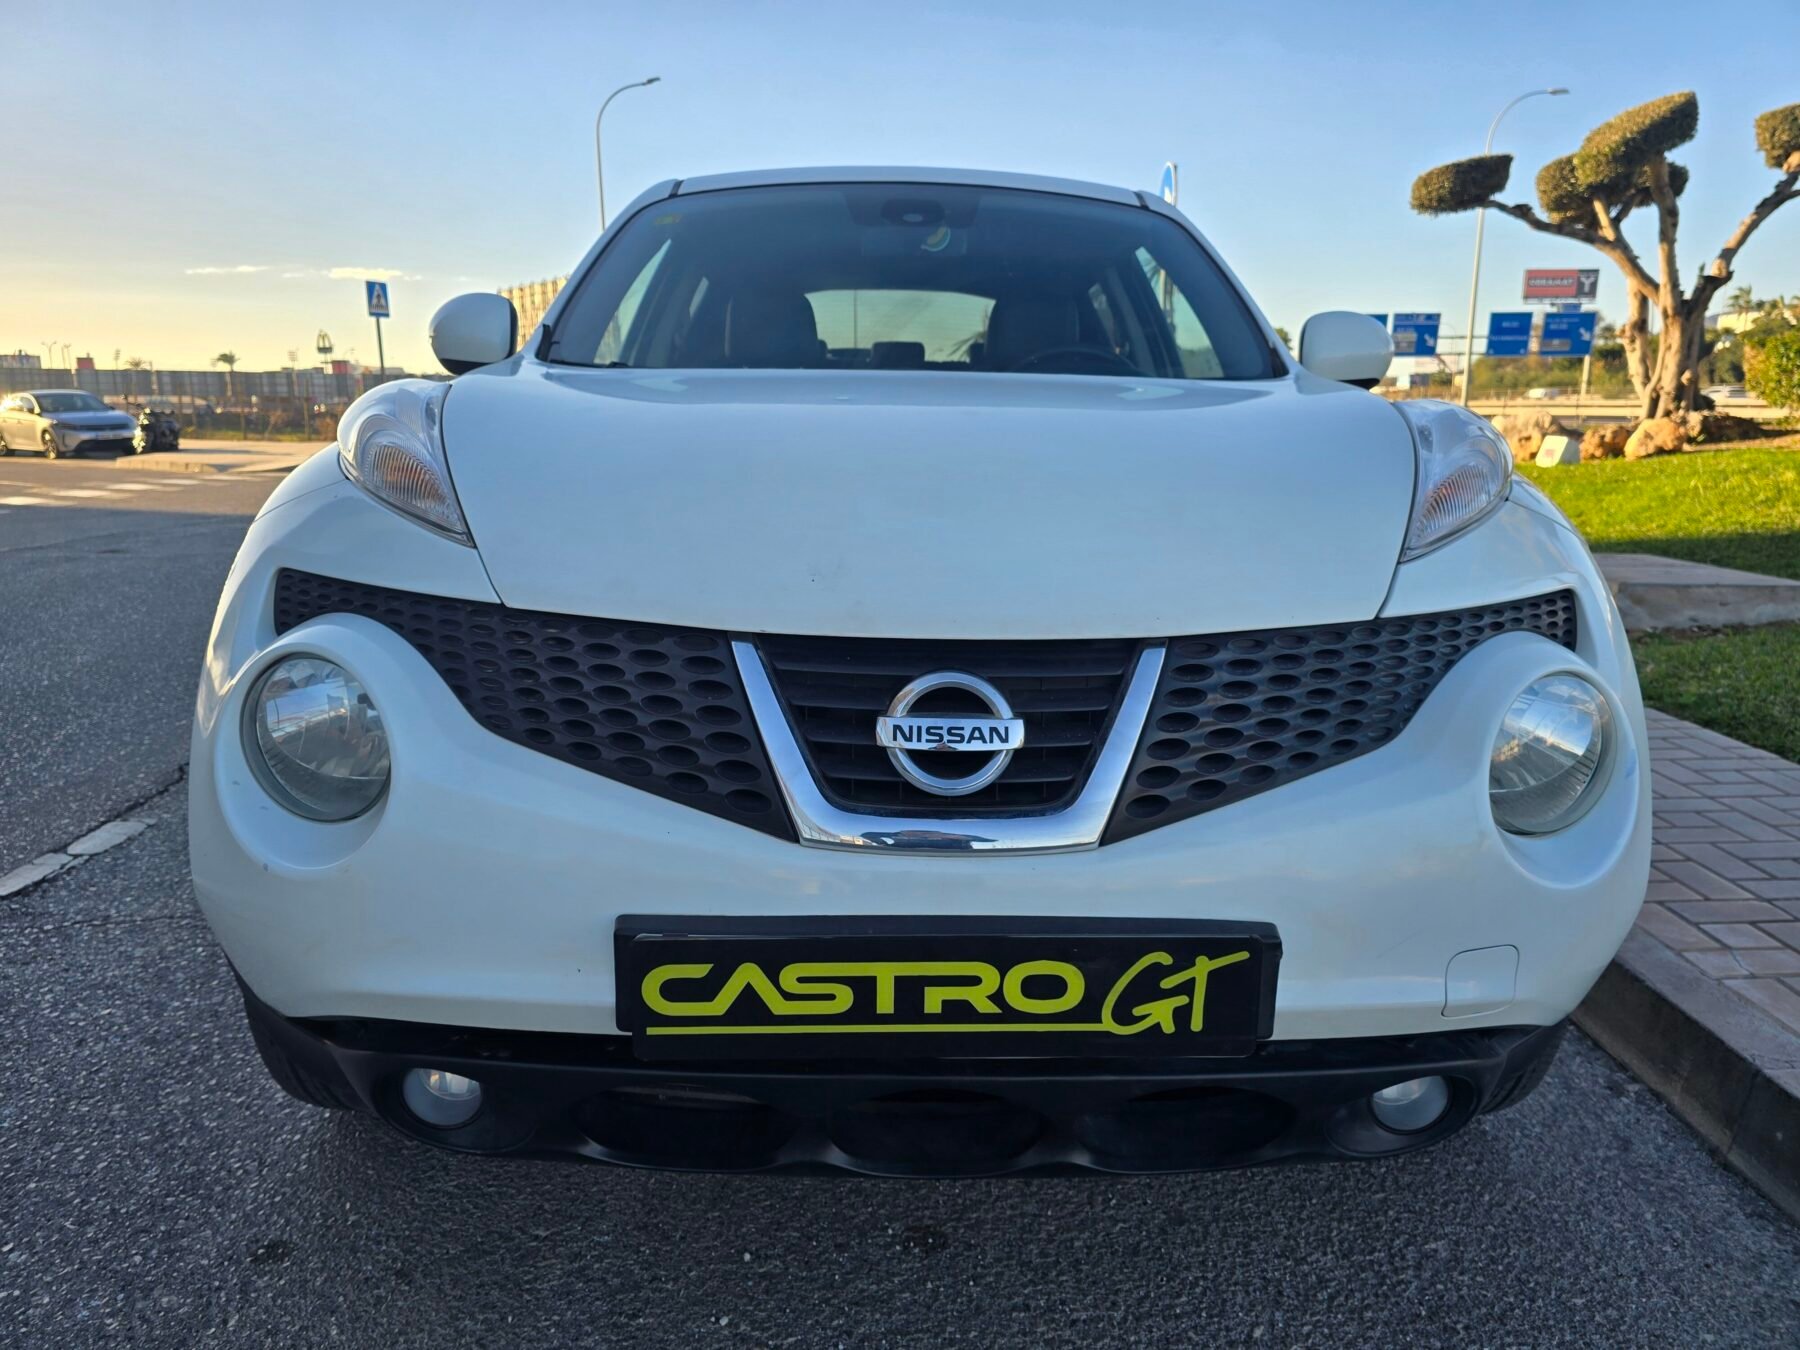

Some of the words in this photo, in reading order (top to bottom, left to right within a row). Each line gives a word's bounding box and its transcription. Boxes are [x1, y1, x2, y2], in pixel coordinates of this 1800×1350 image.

[892, 724, 1009, 744] NISSAN
[641, 959, 1085, 1016] CASTRO
[1101, 951, 1250, 1035] GT
